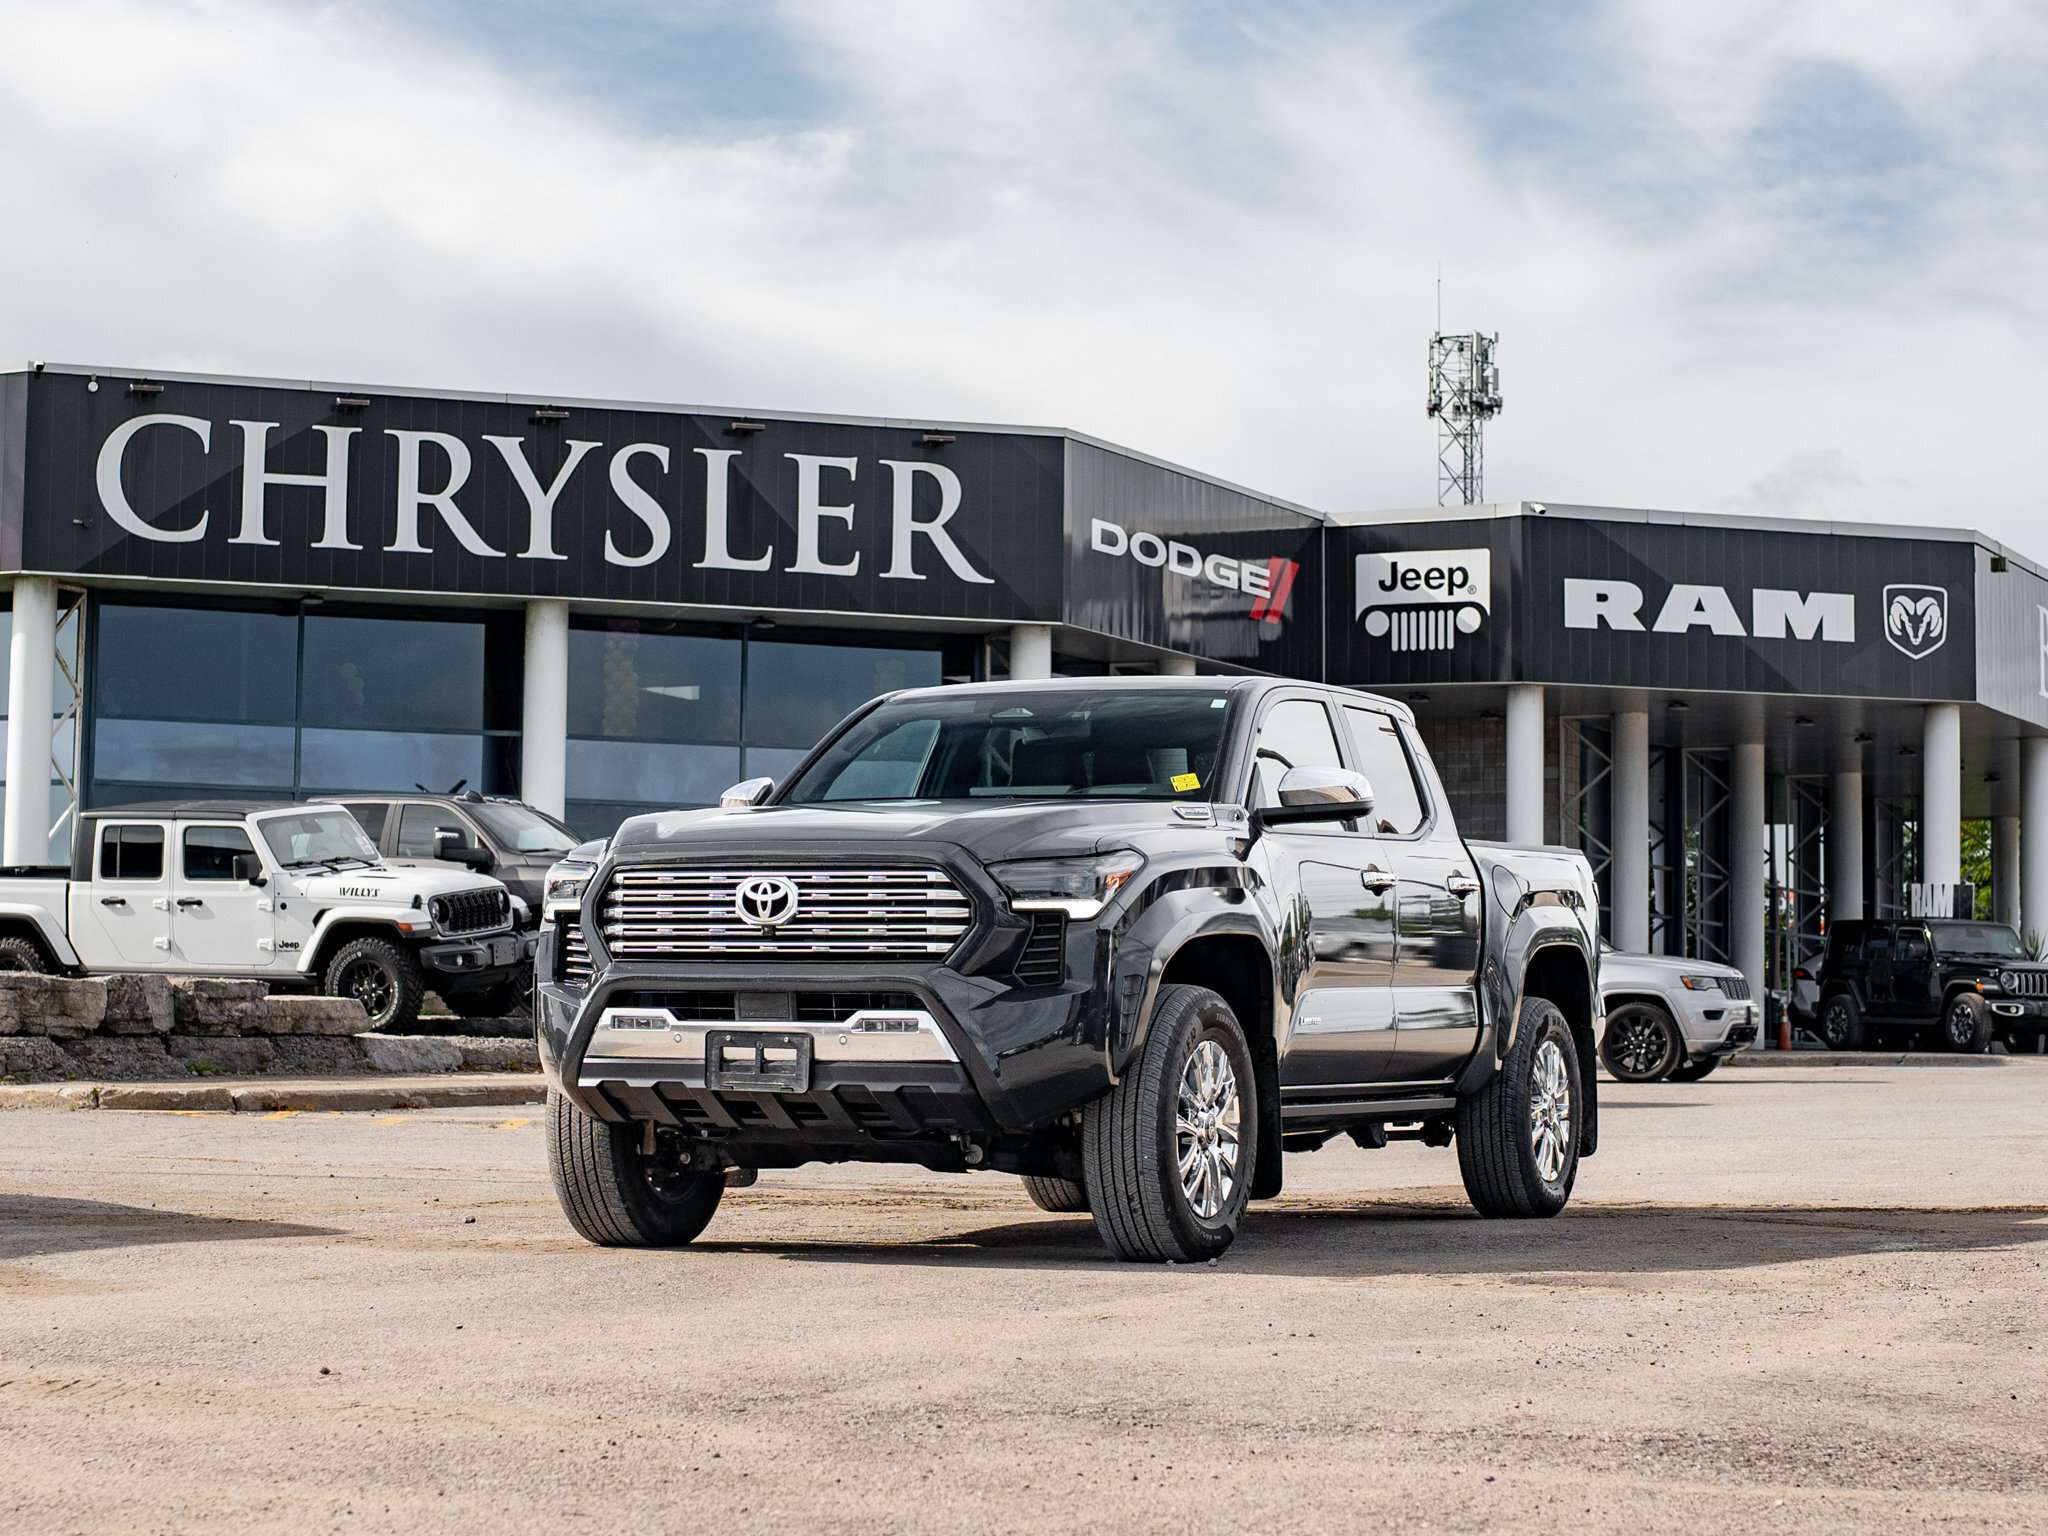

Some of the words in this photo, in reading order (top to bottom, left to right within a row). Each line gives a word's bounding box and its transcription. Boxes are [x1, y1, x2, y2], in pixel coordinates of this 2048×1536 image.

[96, 414, 995, 584] CHRYSLER
[1091, 518, 1271, 599] DODGE
[1378, 561, 1469, 596] Jeep
[1564, 578, 1855, 643] RAM
[1911, 883, 1954, 918] RAM
[279, 940, 300, 950] Jeep
